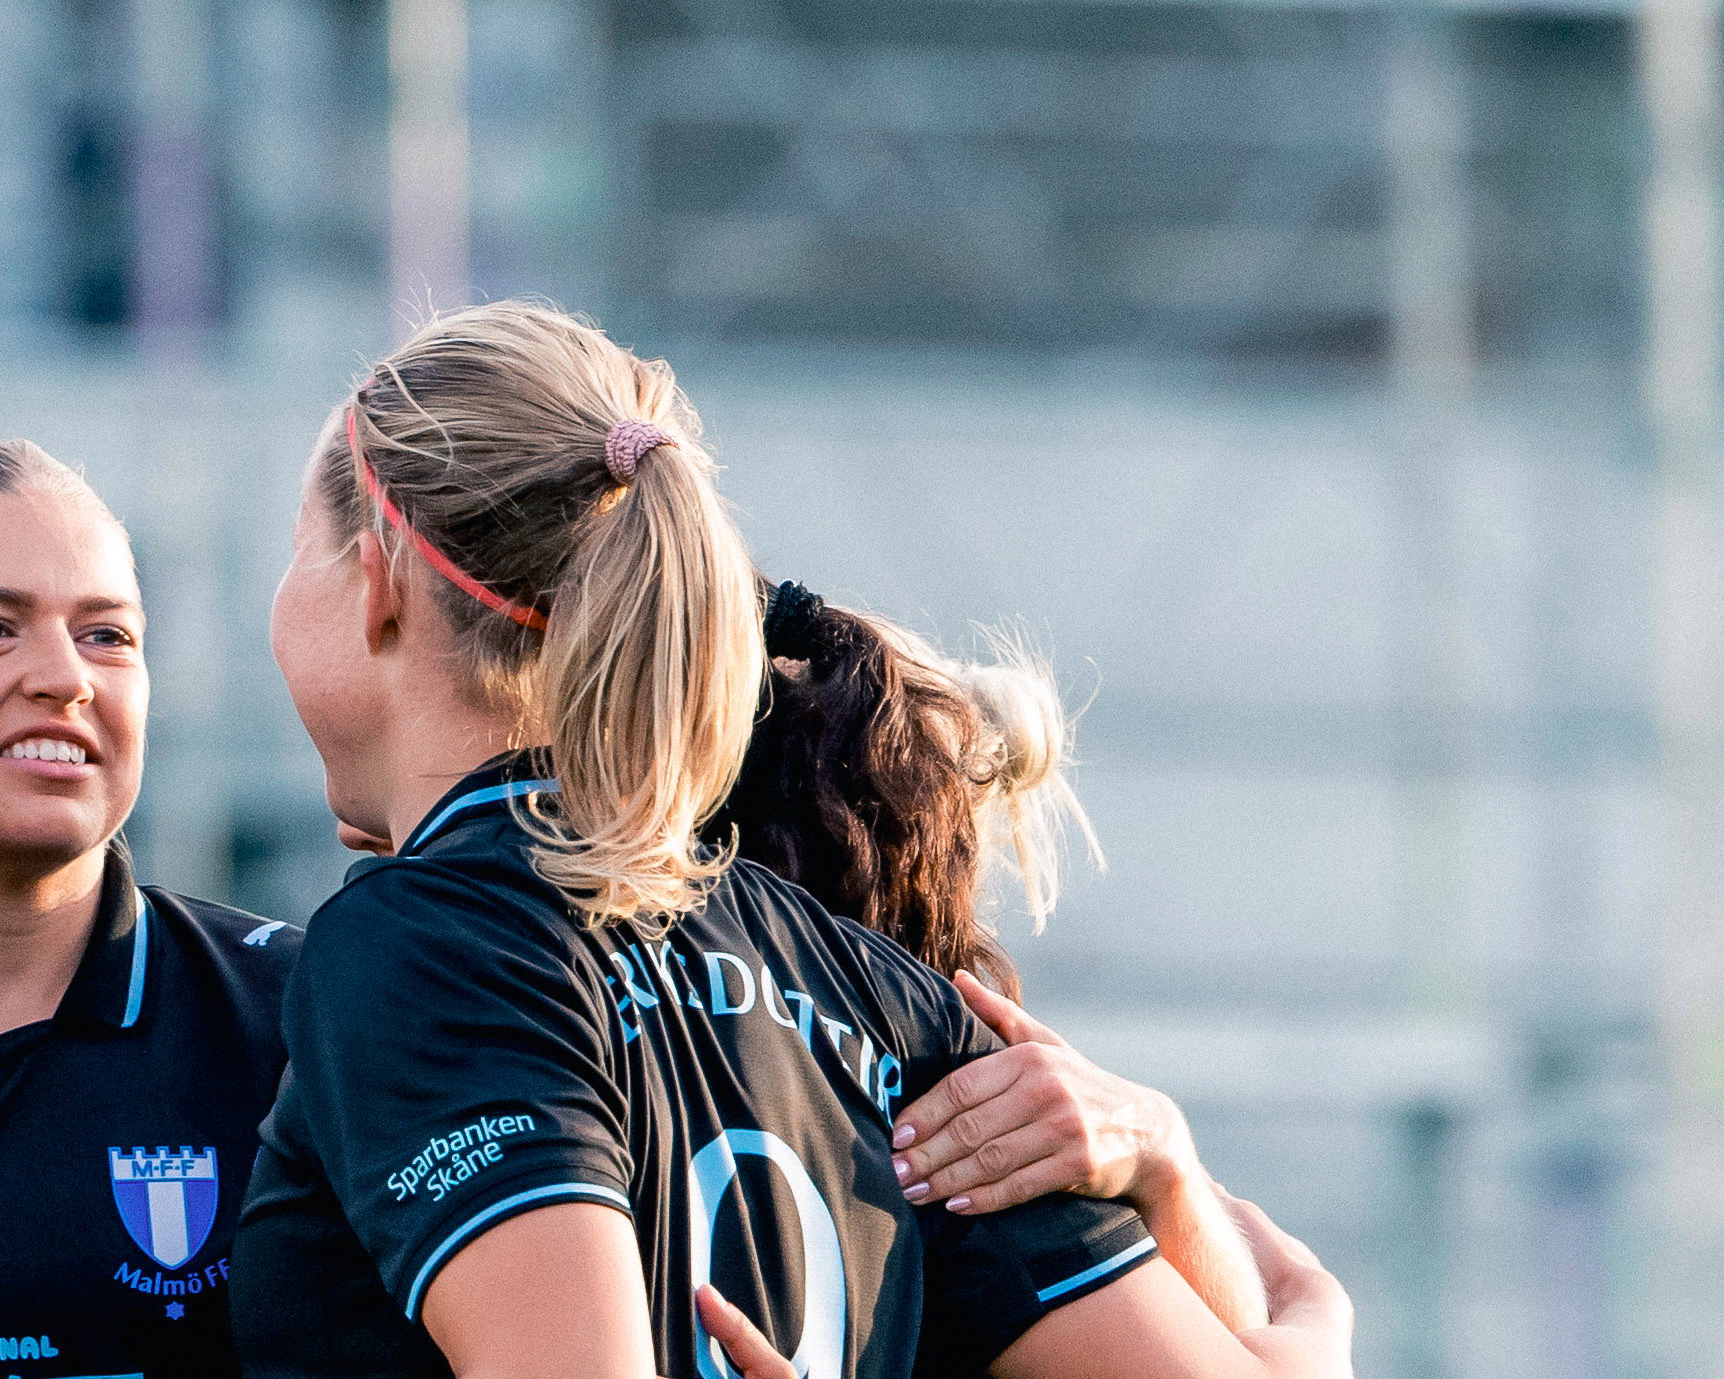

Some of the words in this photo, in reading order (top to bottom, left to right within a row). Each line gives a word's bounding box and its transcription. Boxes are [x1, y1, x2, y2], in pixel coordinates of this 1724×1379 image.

[387, 1114, 536, 1202] Sparbanken
[427, 1141, 504, 1202] Skåne
[113, 1261, 202, 1295] Malmö
